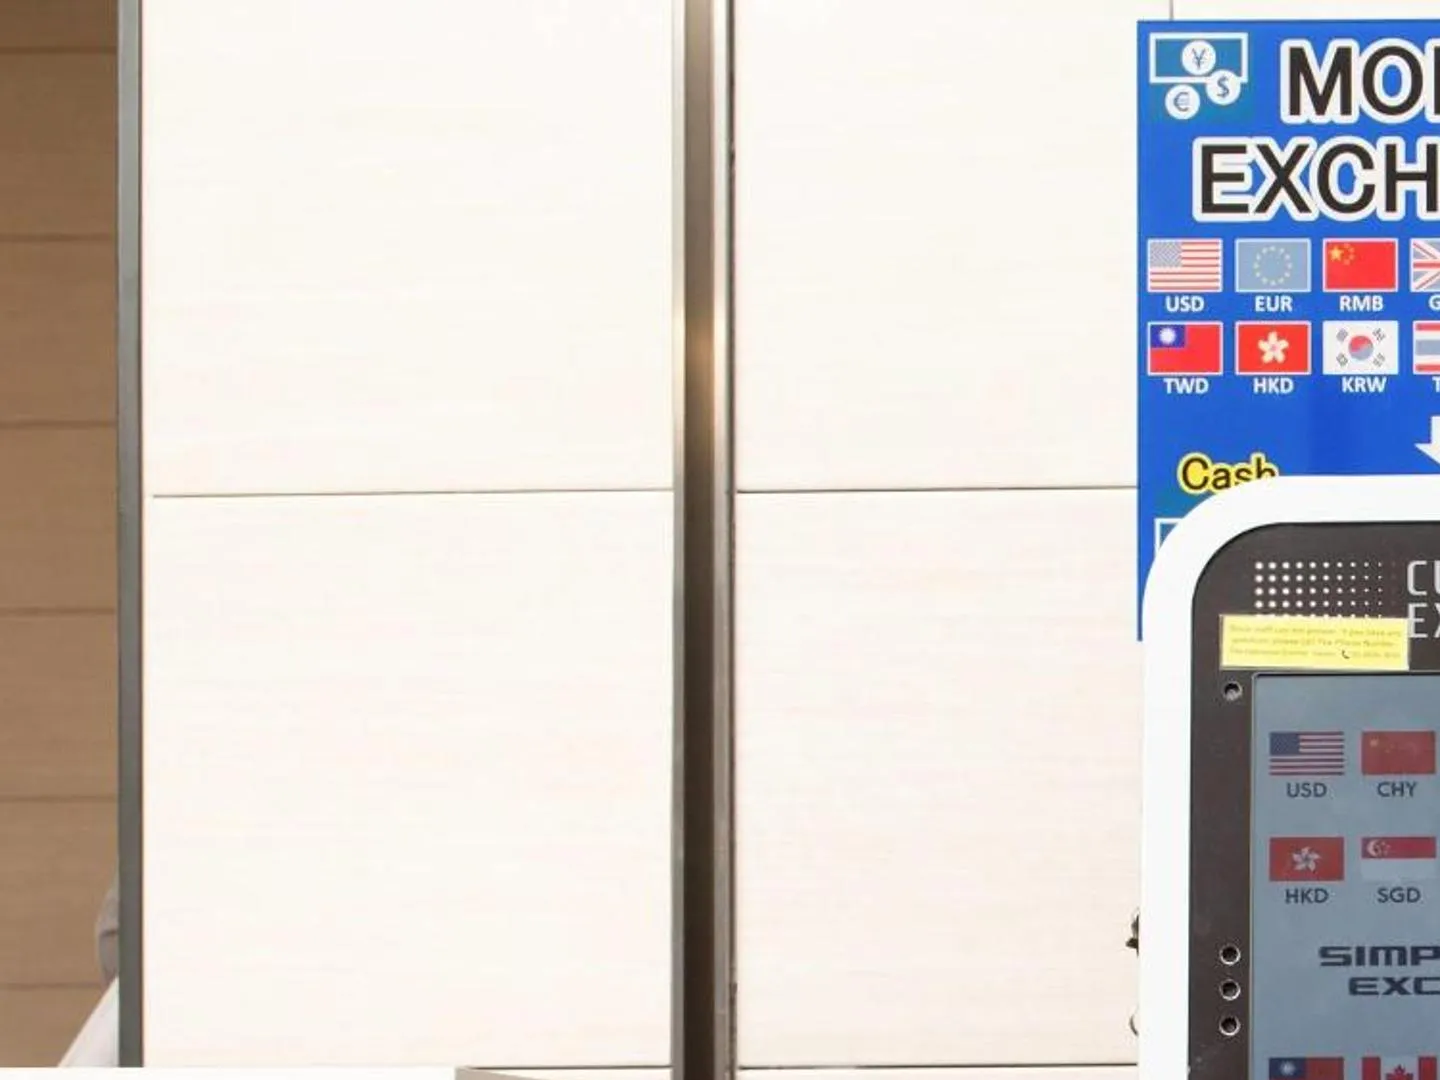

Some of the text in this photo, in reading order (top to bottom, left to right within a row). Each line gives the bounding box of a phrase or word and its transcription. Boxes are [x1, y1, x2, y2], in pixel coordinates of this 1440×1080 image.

[1165, 295, 1204, 313] USD
[1254, 295, 1293, 313] EUR
[1339, 295, 1384, 312] RMB
[1163, 377, 1209, 394] TWD
[1253, 377, 1294, 394] HKD
[1341, 376, 1387, 393] KRW
[1181, 457, 1277, 491] Cash
[1287, 782, 1327, 798] USD
[1377, 781, 1417, 798] CHY
[1285, 888, 1329, 904] HKD
[1377, 887, 1421, 904] SGD
